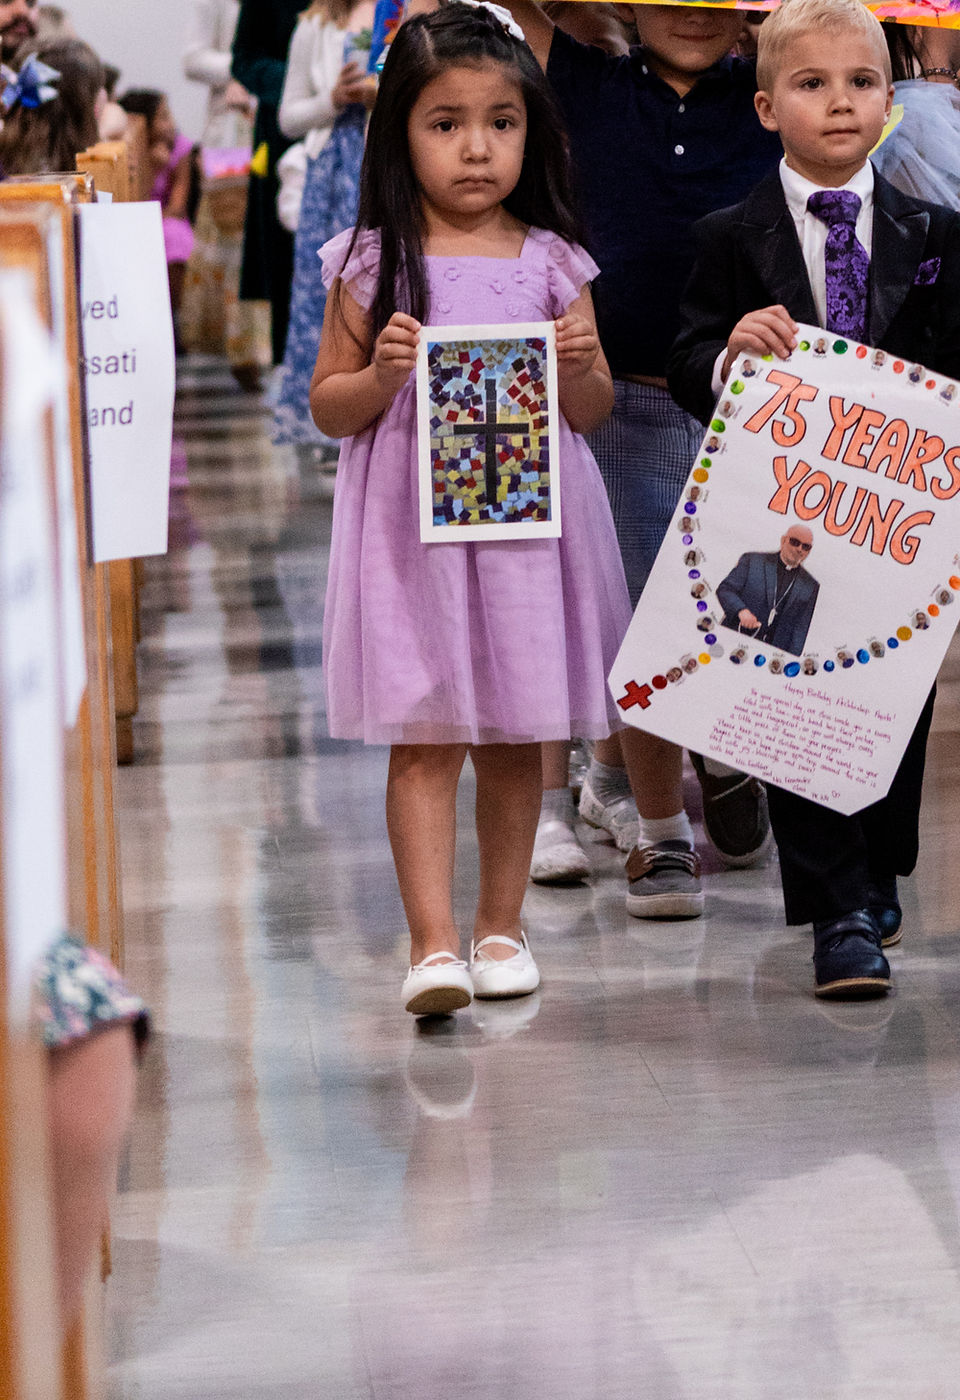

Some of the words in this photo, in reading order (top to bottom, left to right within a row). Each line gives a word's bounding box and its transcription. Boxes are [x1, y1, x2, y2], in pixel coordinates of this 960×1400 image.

[743, 369, 819, 448] 75
[767, 455, 935, 565] YOUNG
[759, 693, 772, 705] your
[772, 697, 792, 708] special
[851, 724, 863, 733] you
[784, 682, 804, 699] Happy
[806, 687, 831, 706] Birthday
[835, 696, 870, 715] Archbishop
[737, 713, 752, 724] little
[750, 709, 763, 718] and
[810, 729, 822, 739] you
[835, 736, 856, 751] always
[758, 700, 772, 712] with
[791, 712, 805, 722] each
[807, 716, 823, 728] bead
[825, 721, 836, 732] has
[838, 726, 854, 737] their
[716, 717, 735, 729] Please
[738, 724, 752, 735] keep
[764, 734, 776, 742] and
[801, 746, 822, 758] around
[825, 753, 834, 763] the
[864, 770, 879, 778] your
[759, 736, 774, 751] hope
[783, 759, 796, 767] and
